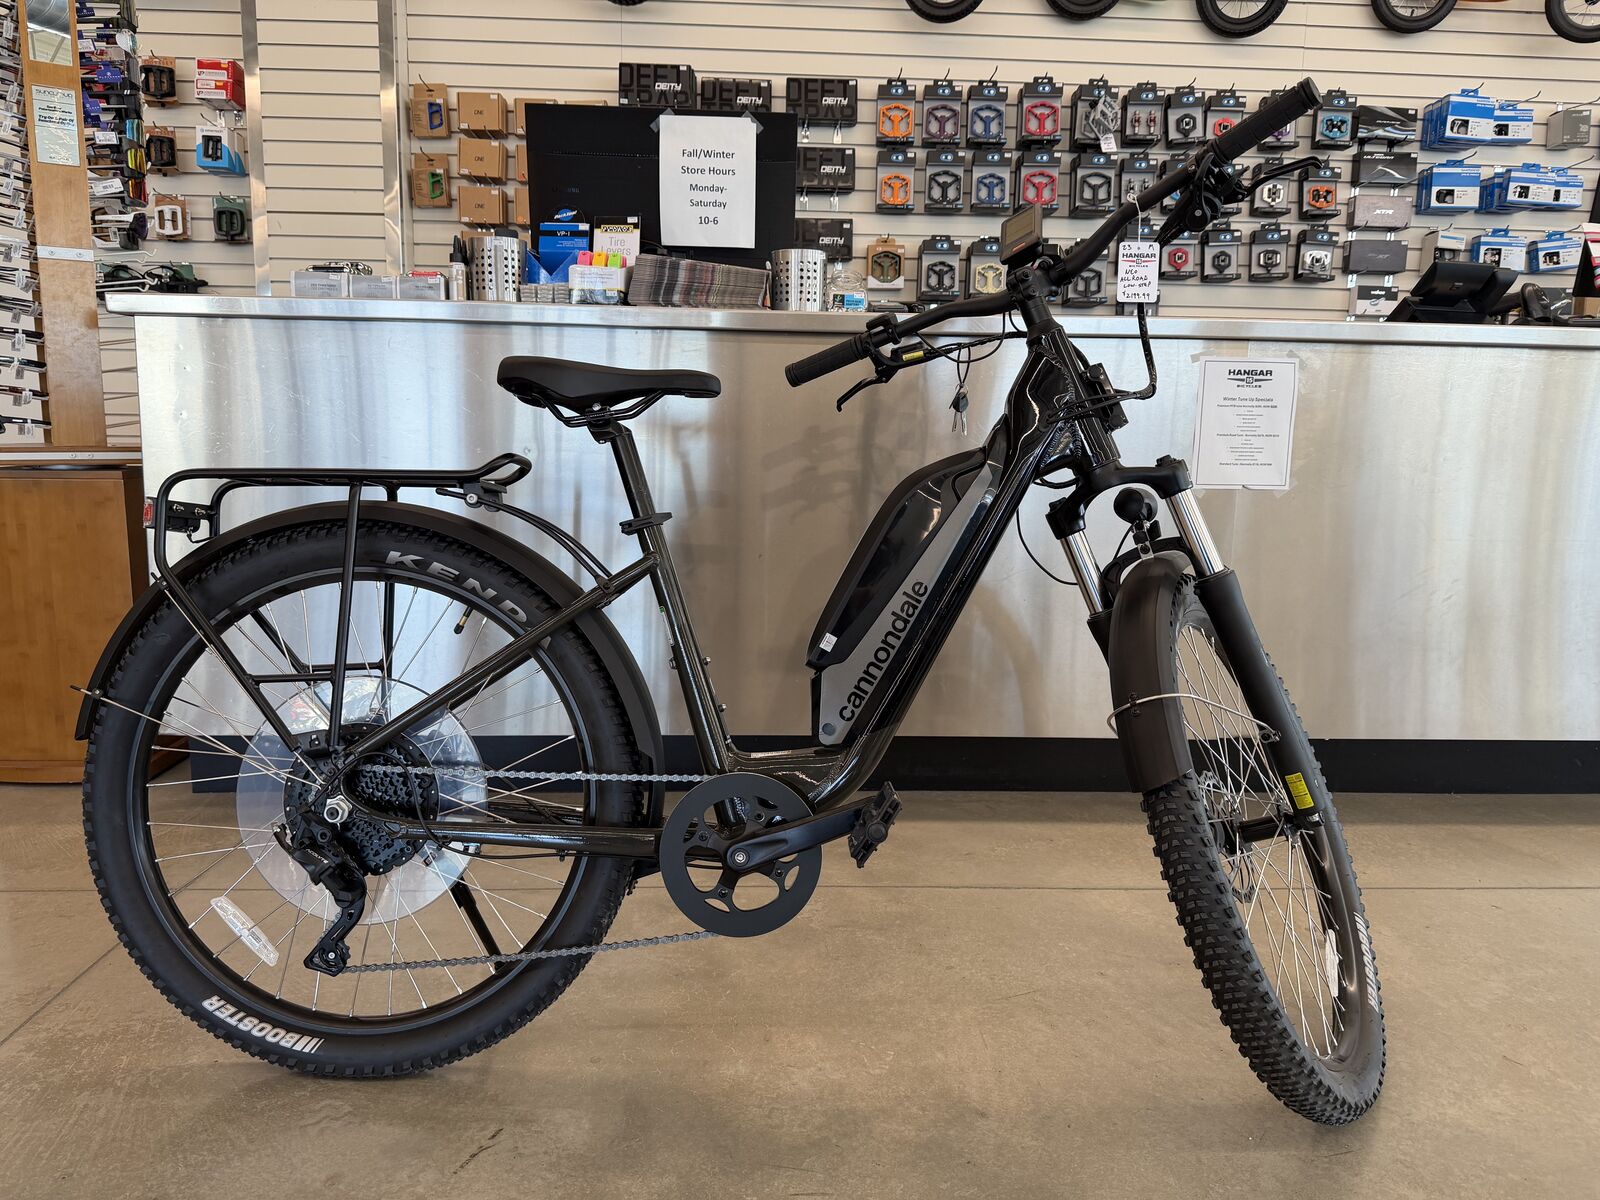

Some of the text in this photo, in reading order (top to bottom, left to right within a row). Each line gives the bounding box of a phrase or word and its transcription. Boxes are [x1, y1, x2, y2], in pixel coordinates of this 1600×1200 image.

[655, 83, 682, 91] DEITY
[736, 96, 763, 104] DEITY
[822, 96, 848, 105] DEITY
[682, 148, 736, 160] Fall/Winter
[680, 165, 736, 176] Store Hours
[820, 165, 847, 174] DEITY
[689, 183, 728, 194] Monday-
[689, 198, 727, 209] Saturday
[698, 215, 719, 225] 10-6
[608, 236, 626, 247] Tire
[818, 236, 845, 245] DEITY
[839, 581, 929, 722] cannondale
[1357, 929, 1380, 1014] BOOSTER
[201, 995, 303, 1050] BOOSTER
